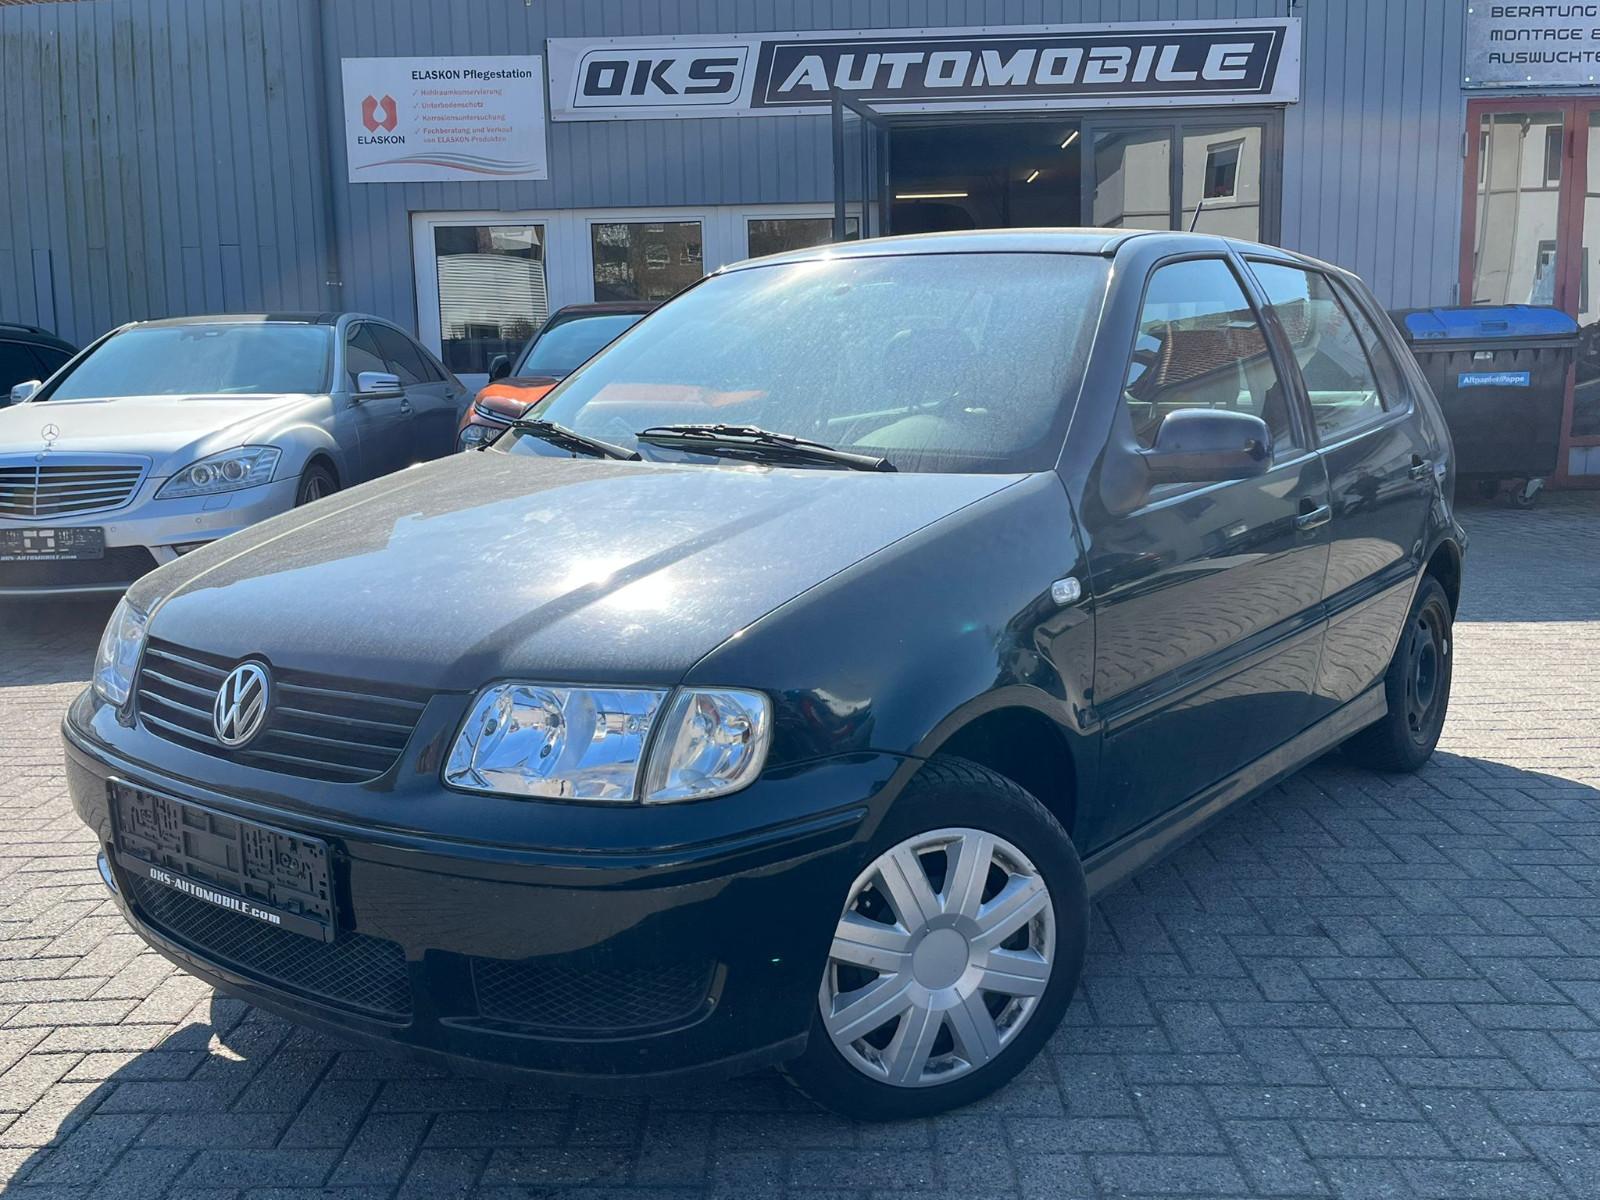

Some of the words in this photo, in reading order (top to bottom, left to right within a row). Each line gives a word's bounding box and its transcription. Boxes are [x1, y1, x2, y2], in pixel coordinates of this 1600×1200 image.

[1491, 5, 1598, 18] BERATUNG
[1490, 28, 1583, 41] MONTAGE
[411, 70, 460, 80] ELASKON
[463, 69, 532, 80] Pflegestation
[583, 57, 739, 96] OKS
[777, 43, 1255, 92] AUTOMOBILE
[357, 136, 405, 145] ELASKON
[437, 136, 470, 144] ELASKON
[149, 867, 281, 925] OKS-AUTOMOBILE.com
